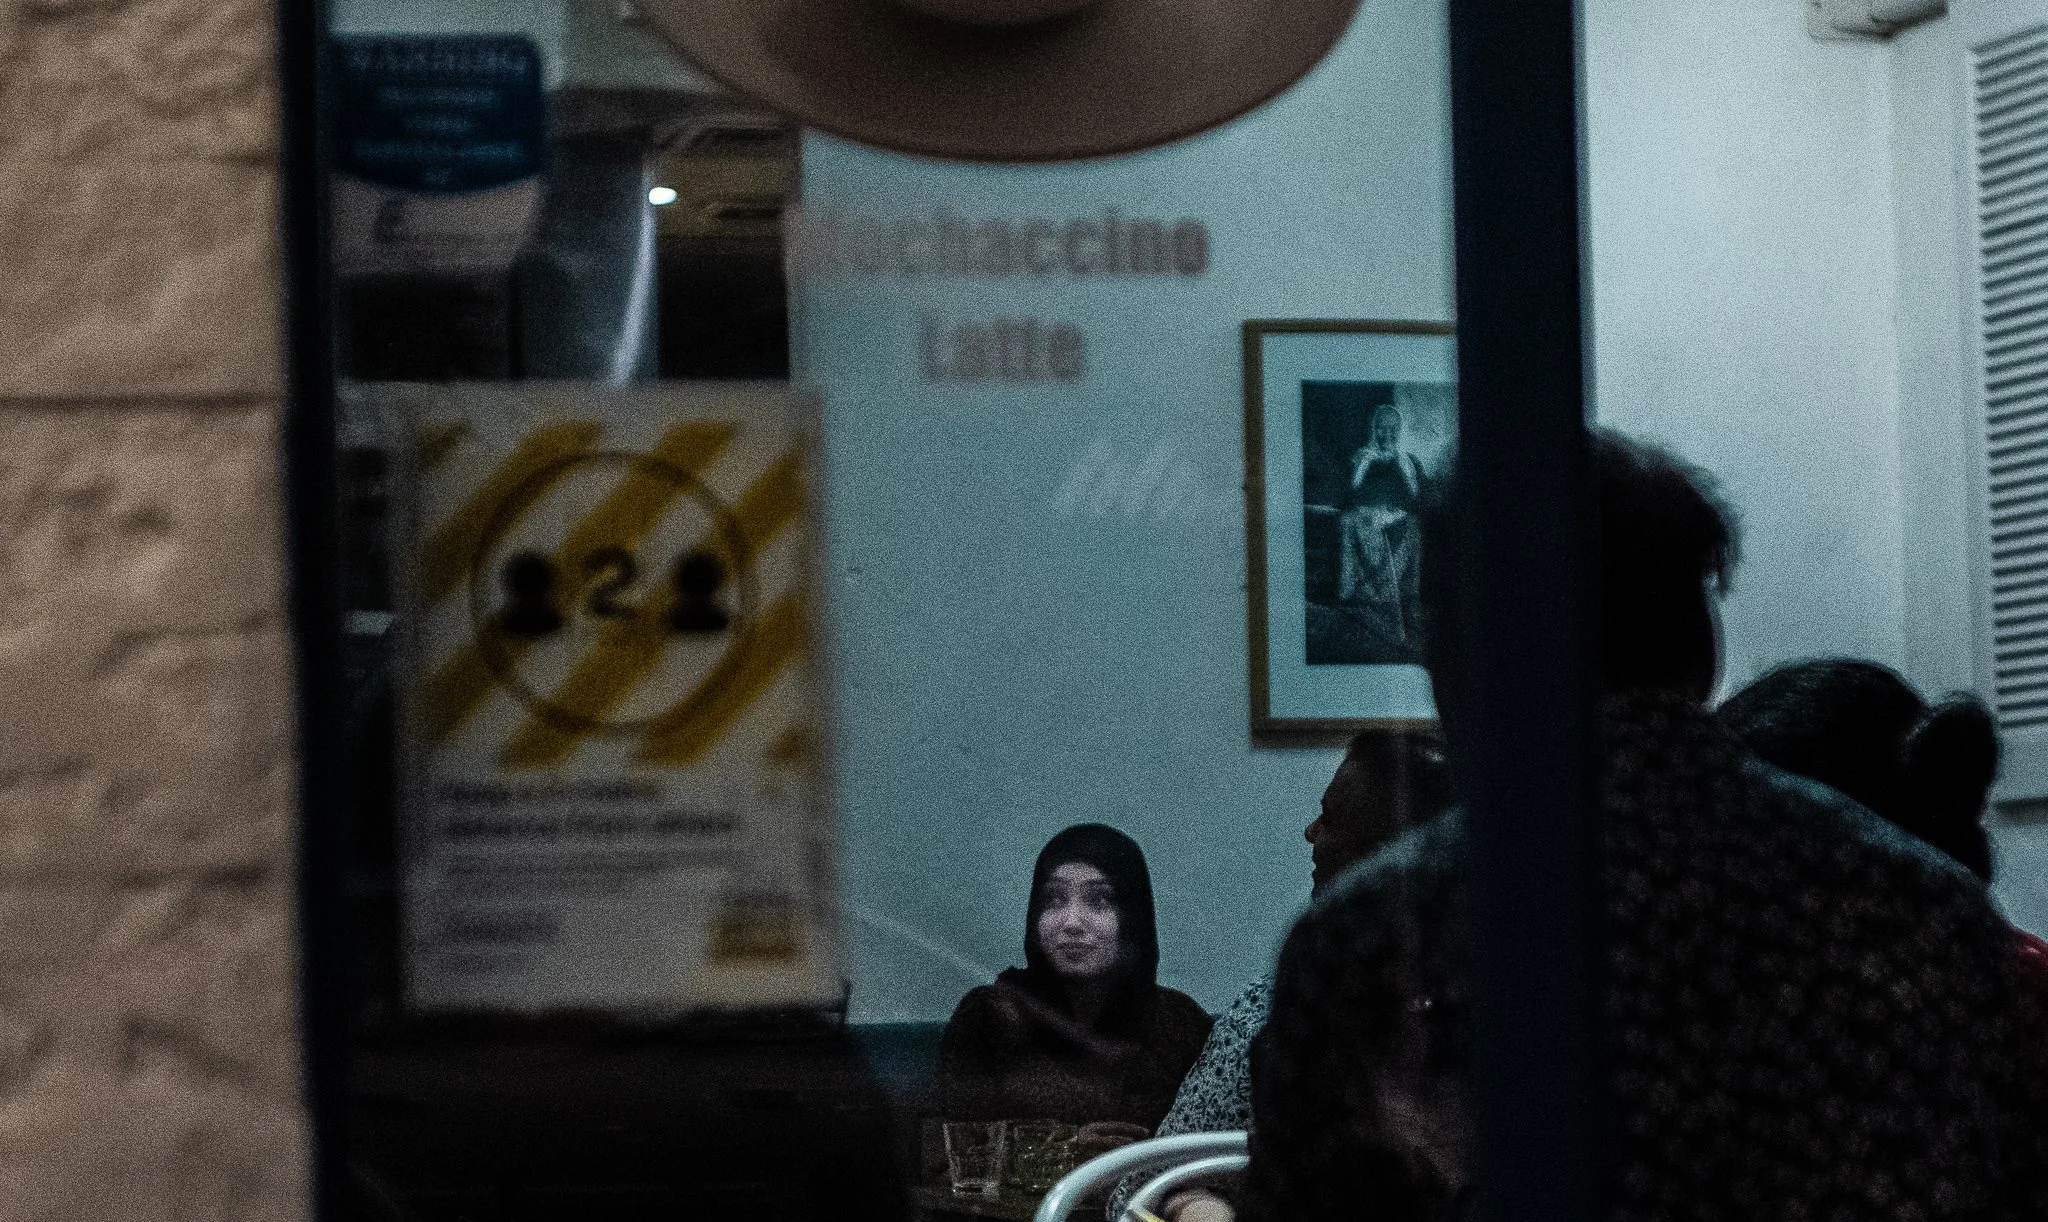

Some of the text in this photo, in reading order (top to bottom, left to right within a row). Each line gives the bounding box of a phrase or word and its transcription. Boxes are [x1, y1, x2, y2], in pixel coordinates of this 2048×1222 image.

[793, 206, 1210, 277] ochaccino
[919, 318, 1087, 381] Latte
[583, 544, 638, 618] 2
